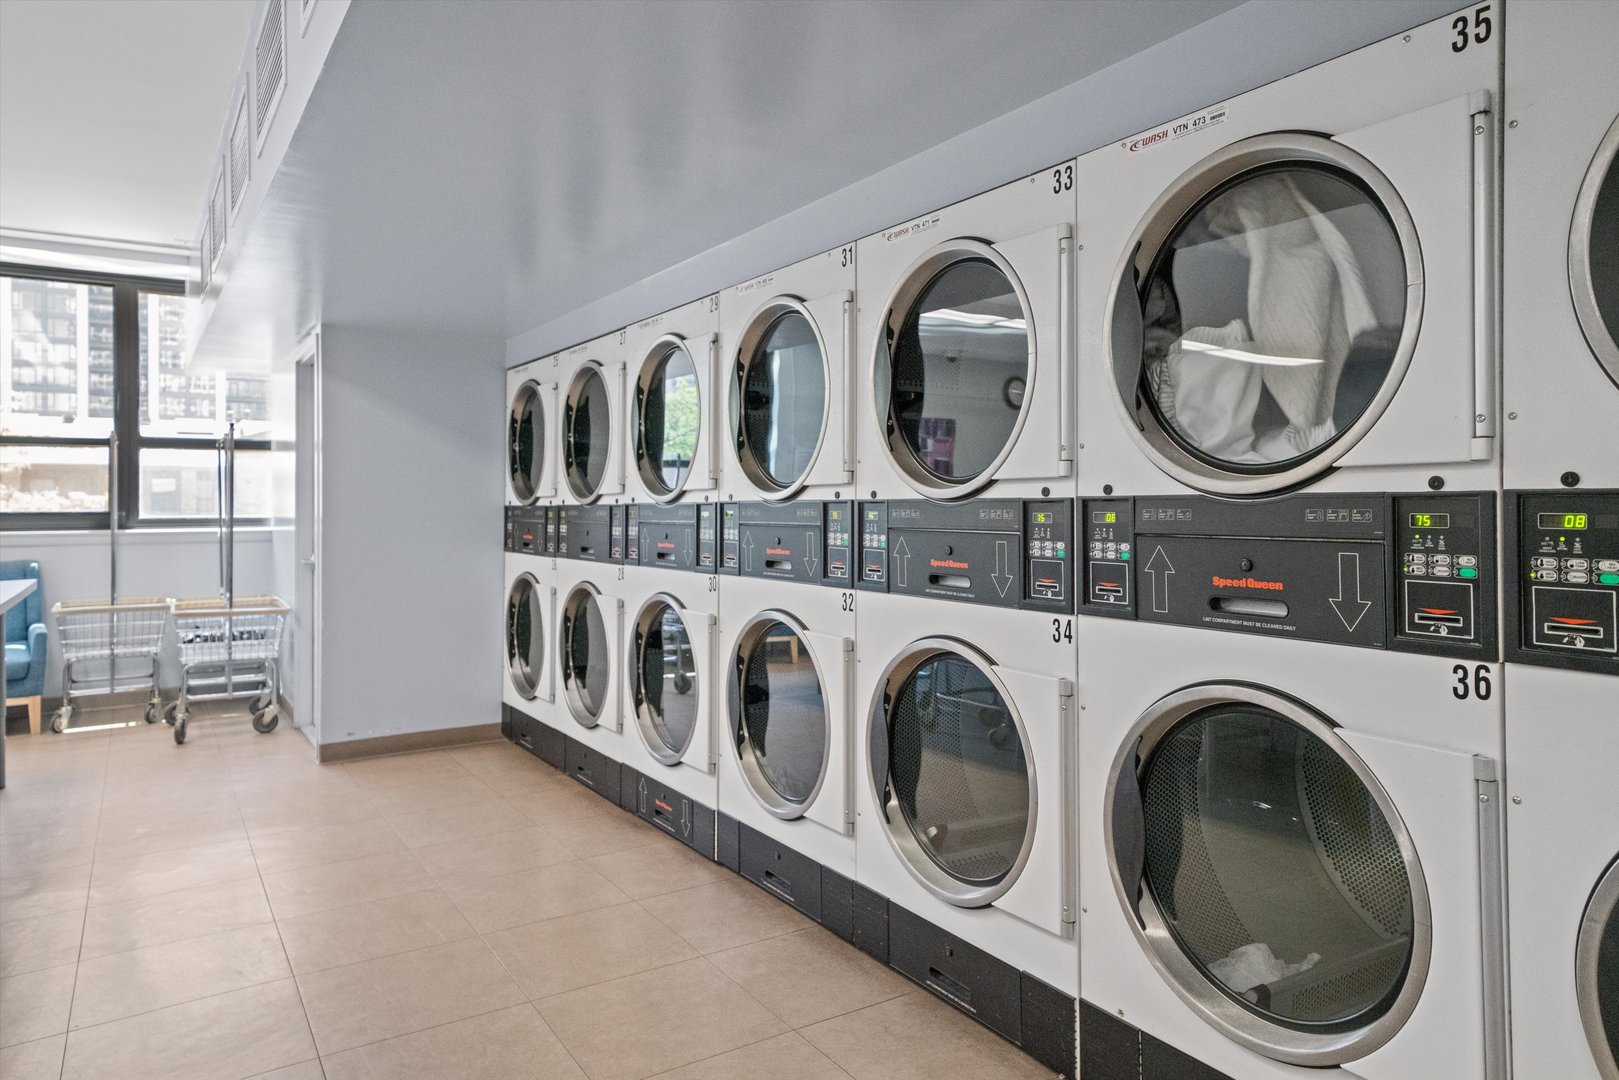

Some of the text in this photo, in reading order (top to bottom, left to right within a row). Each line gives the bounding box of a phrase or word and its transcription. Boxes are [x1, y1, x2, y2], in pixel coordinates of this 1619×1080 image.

[1452, 4, 1492, 53] 35
[1173, 123, 1189, 135] VTN
[1192, 116, 1206, 127] 473
[1142, 130, 1168, 146] WASH
[1053, 165, 1073, 194] 33
[842, 245, 853, 267] 31
[710, 295, 719, 313] 29
[1415, 515, 1431, 526] 75
[1564, 515, 1586, 528] 08
[708, 575, 717, 592] 30
[1212, 576, 1284, 590] Speed Queen
[842, 592, 854, 612] 32
[1052, 618, 1073, 644] 34
[1212, 617, 1243, 626] COMPARTMENT
[1262, 622, 1283, 630] CLEANED
[1452, 664, 1492, 700] 36
